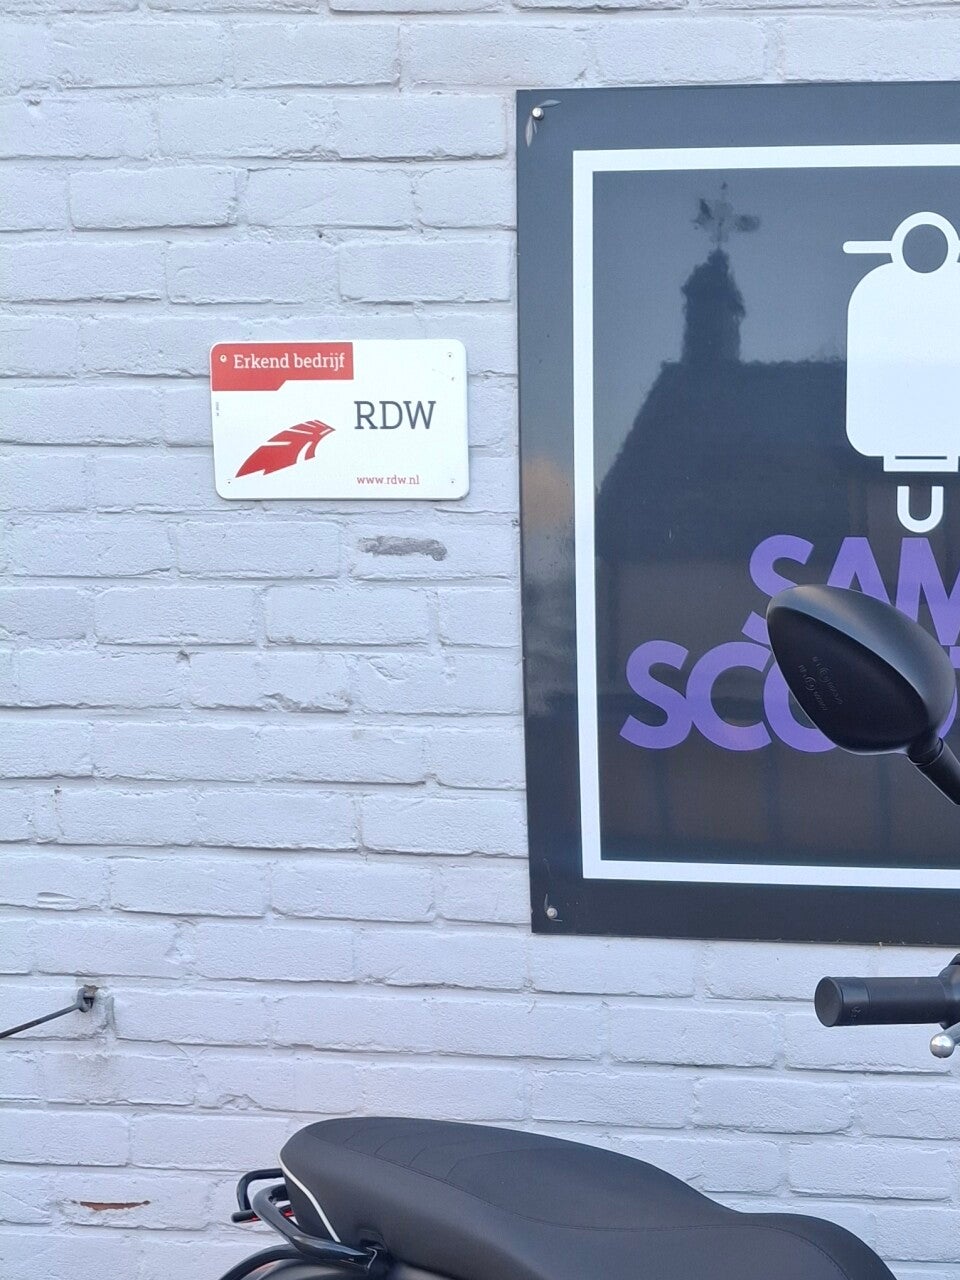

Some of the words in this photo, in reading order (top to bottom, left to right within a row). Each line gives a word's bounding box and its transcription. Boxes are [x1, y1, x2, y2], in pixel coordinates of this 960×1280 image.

[233, 353, 290, 370] Erkend
[293, 352, 346, 372] bedrijf
[353, 400, 437, 430] RDW
[356, 474, 420, 485] www.rdw.nl
